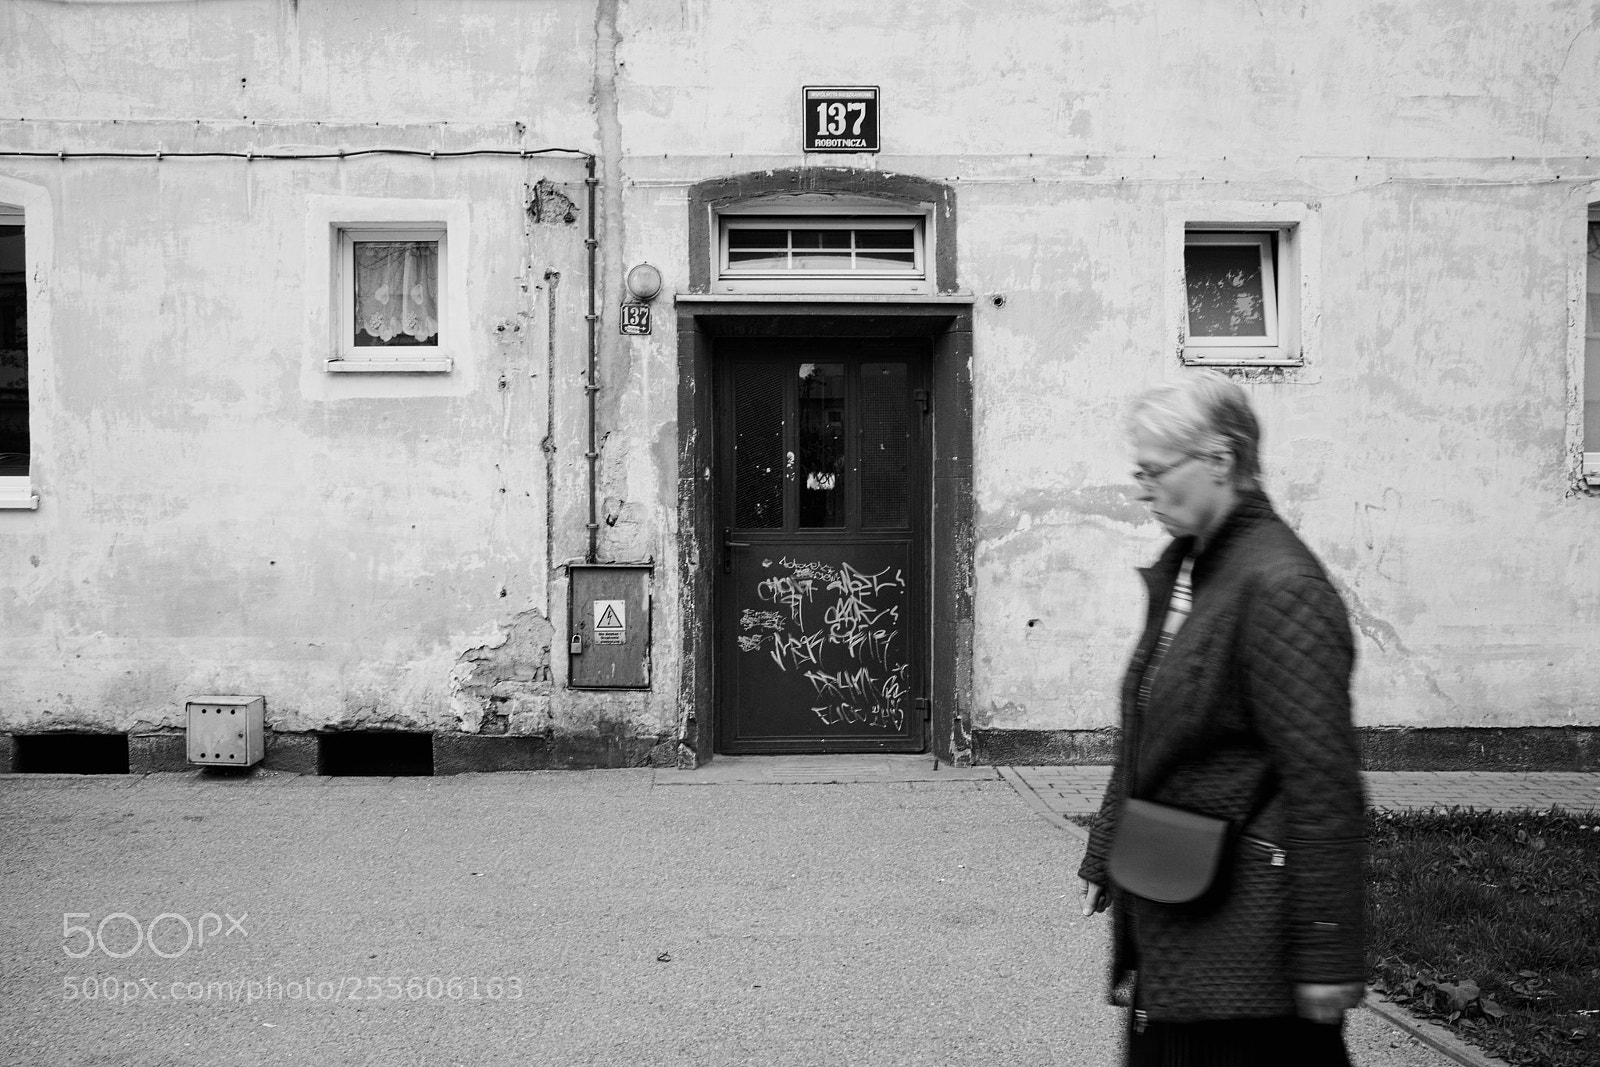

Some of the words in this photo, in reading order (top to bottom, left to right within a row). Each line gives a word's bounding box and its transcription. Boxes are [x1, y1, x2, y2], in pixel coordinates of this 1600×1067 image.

[816, 102, 867, 136] 137
[814, 138, 867, 147] ROBOTNICZA
[622, 306, 649, 326] 137
